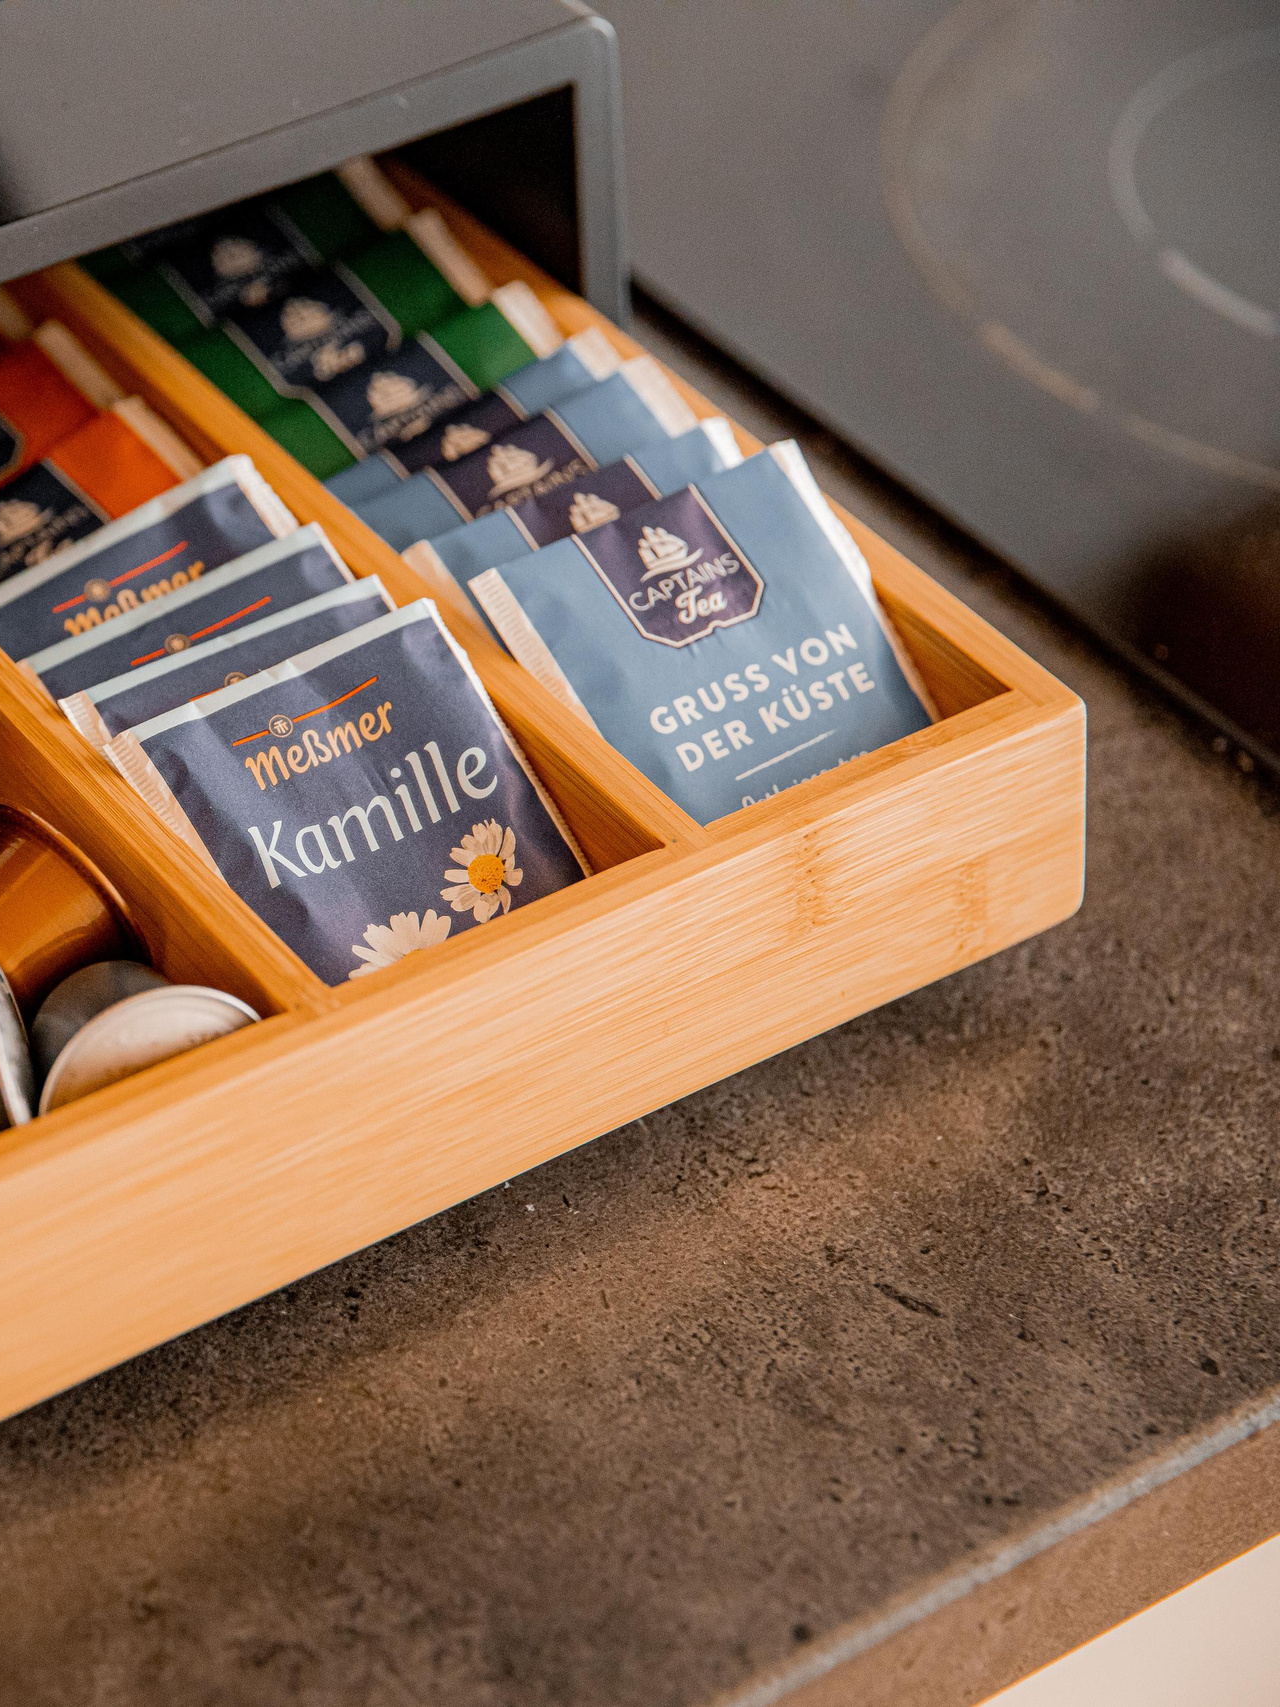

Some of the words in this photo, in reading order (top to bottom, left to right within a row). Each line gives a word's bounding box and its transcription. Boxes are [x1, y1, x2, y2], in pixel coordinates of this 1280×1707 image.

[629, 552, 740, 611] CAPTAINS
[675, 586, 727, 624] Tea
[649, 663, 770, 735] GRUSS
[771, 623, 859, 676] VON
[675, 719, 754, 772] DER
[758, 662, 876, 734] KÜSTE
[248, 741, 499, 889] Kamille
